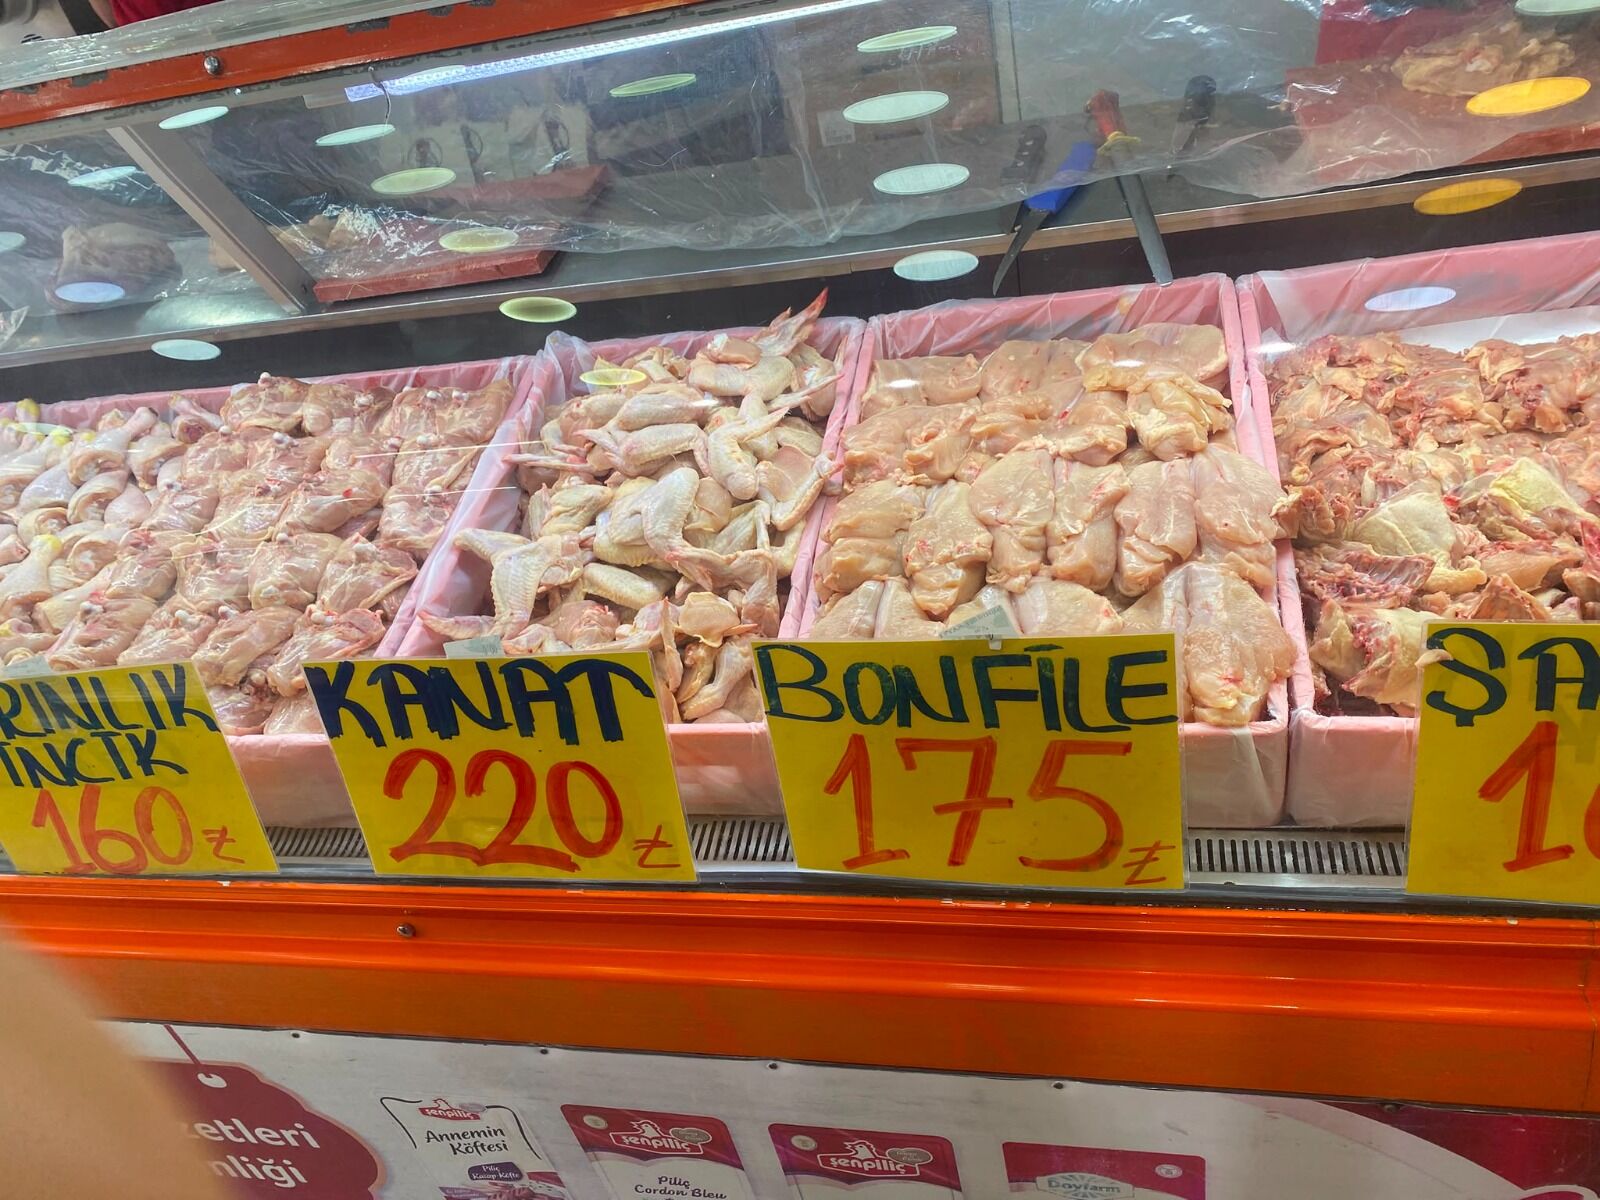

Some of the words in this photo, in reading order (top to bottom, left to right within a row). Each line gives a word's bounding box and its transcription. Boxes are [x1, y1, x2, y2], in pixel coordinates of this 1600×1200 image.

[304, 659, 655, 747] KANAT
[755, 644, 1179, 732] BONFİLE
[1426, 627, 1600, 727] ŞA
[32, 784, 194, 874] 160
[383, 748, 623, 873] 220
[824, 734, 1132, 872] 175
[1478, 721, 1600, 872] 1
[424, 1126, 506, 1144] Annemin
[449, 1139, 509, 1157] Köftesi
[830, 1157, 906, 1175] şenpiliç
[634, 1184, 688, 1196] Cordon
[691, 1188, 727, 1199] Bleu
[658, 1175, 690, 1189] Piliç
